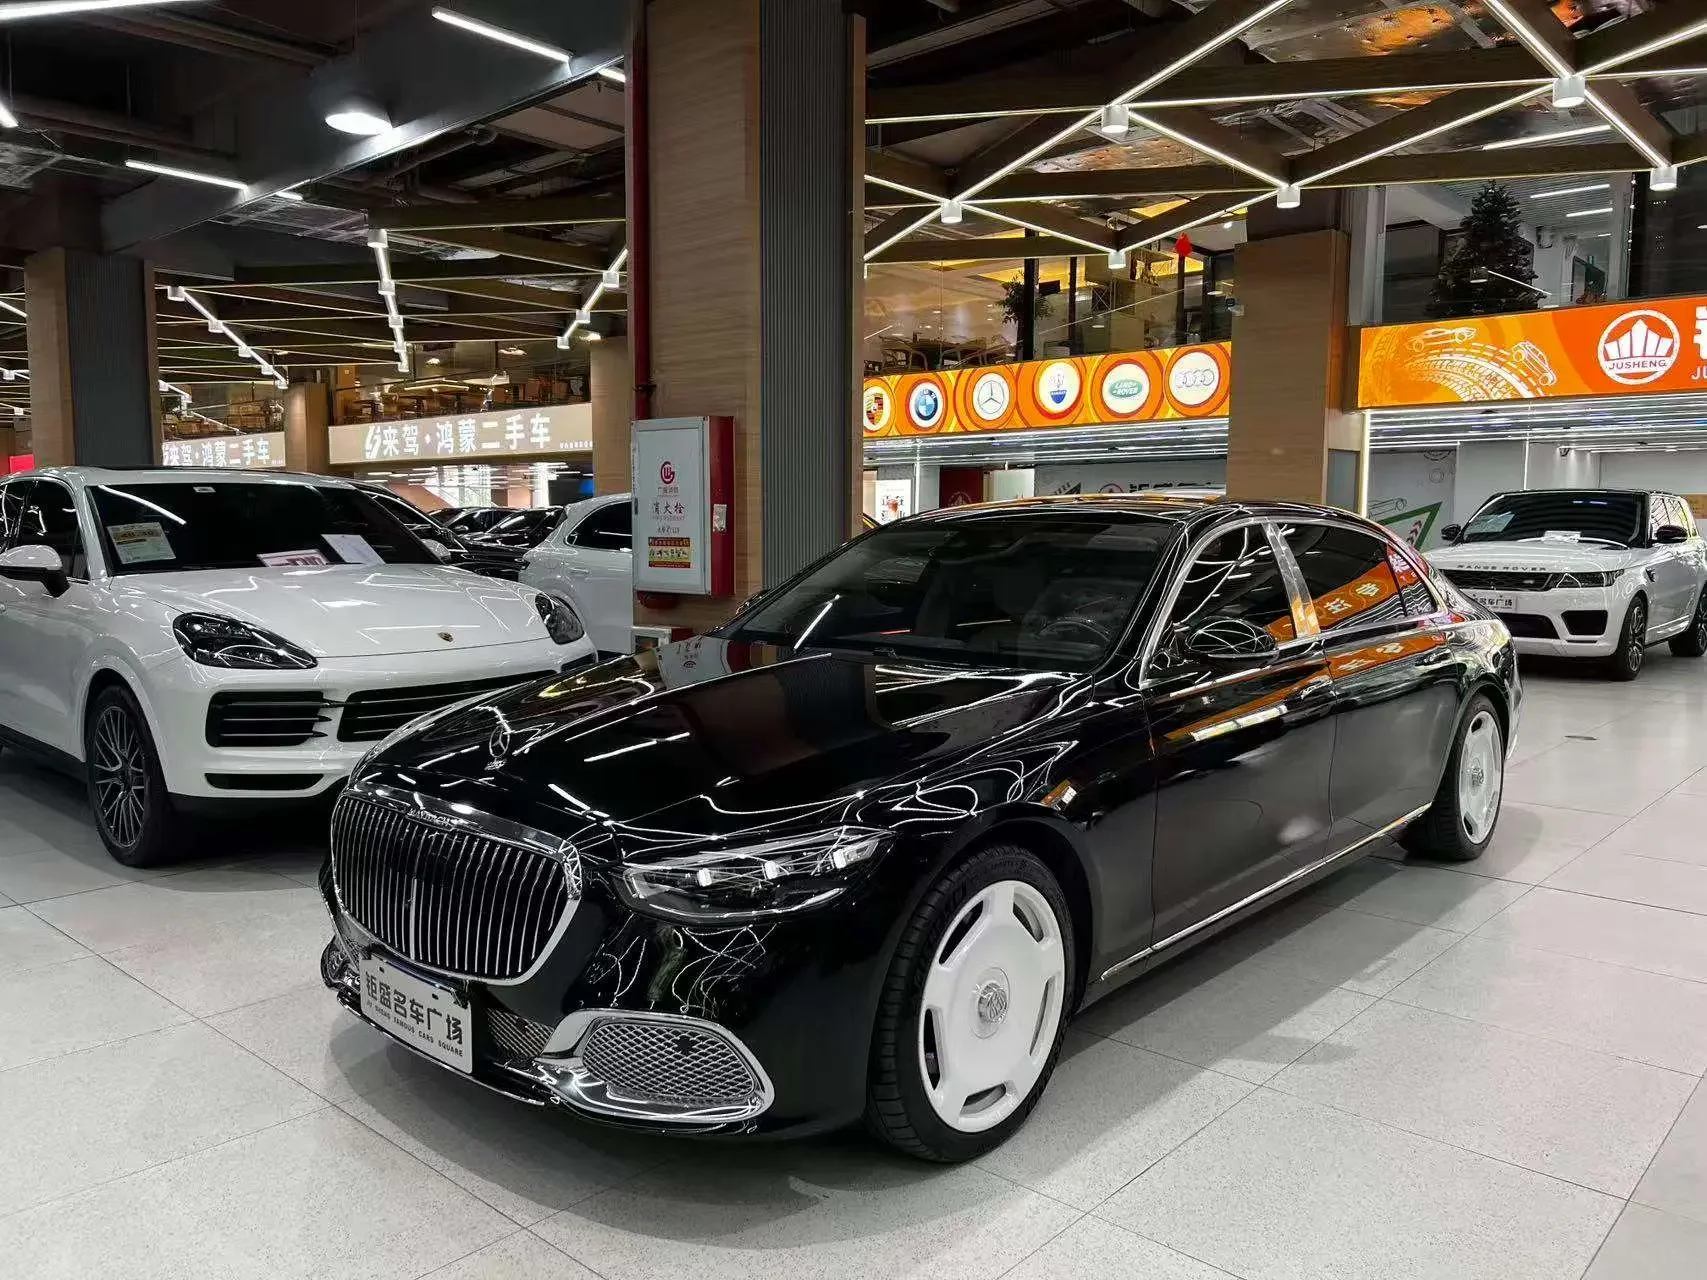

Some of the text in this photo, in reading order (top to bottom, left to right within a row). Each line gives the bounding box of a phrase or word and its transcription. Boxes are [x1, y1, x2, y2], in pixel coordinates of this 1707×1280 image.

[1609, 360, 1667, 369] JUSHENG
[393, 1016, 415, 1034] FAMOUS
[418, 1030, 434, 1043] CARS
[438, 1040, 463, 1057] SQUARE
